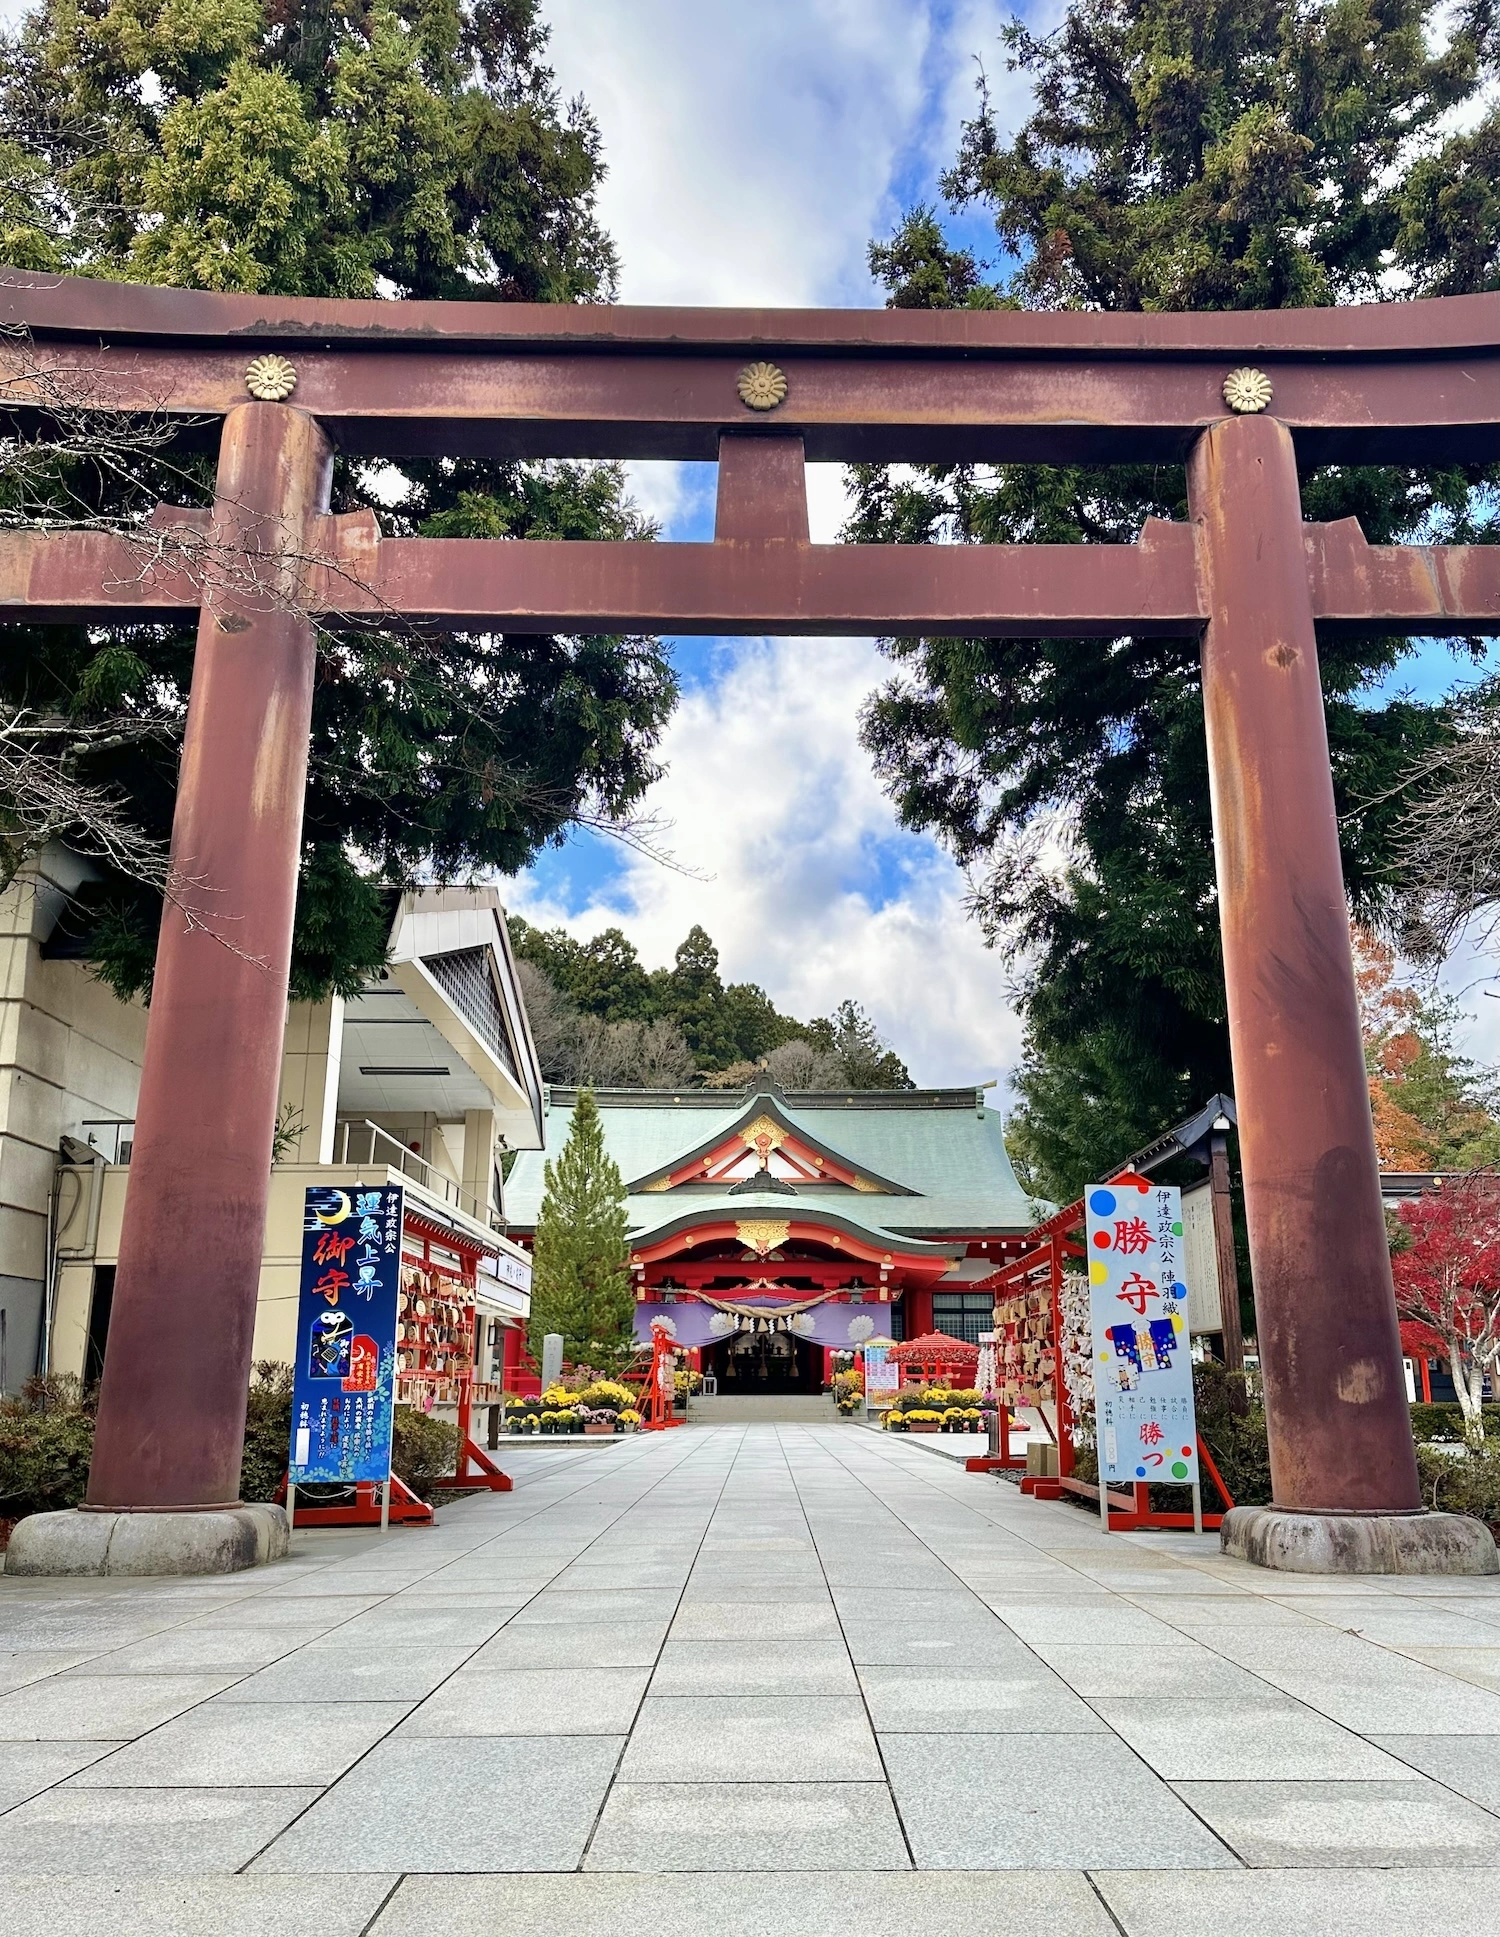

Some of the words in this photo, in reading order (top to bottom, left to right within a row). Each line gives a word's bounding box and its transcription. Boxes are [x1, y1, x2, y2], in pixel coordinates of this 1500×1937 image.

[352, 1192, 384, 1301] 運気上昇
[384, 1192, 399, 1253] 伊達政宗公
[1156, 1190, 1175, 1263] 伊達政宗公
[312, 1231, 355, 1306] 御守
[1113, 1217, 1160, 1315] 勝守
[1162, 1270, 1179, 1315] 陣羽織
[1136, 1331, 1155, 1368] 勝守
[1105, 1400, 1113, 1425] 初穂料
[1140, 1422, 1164, 1467] 勝つ
